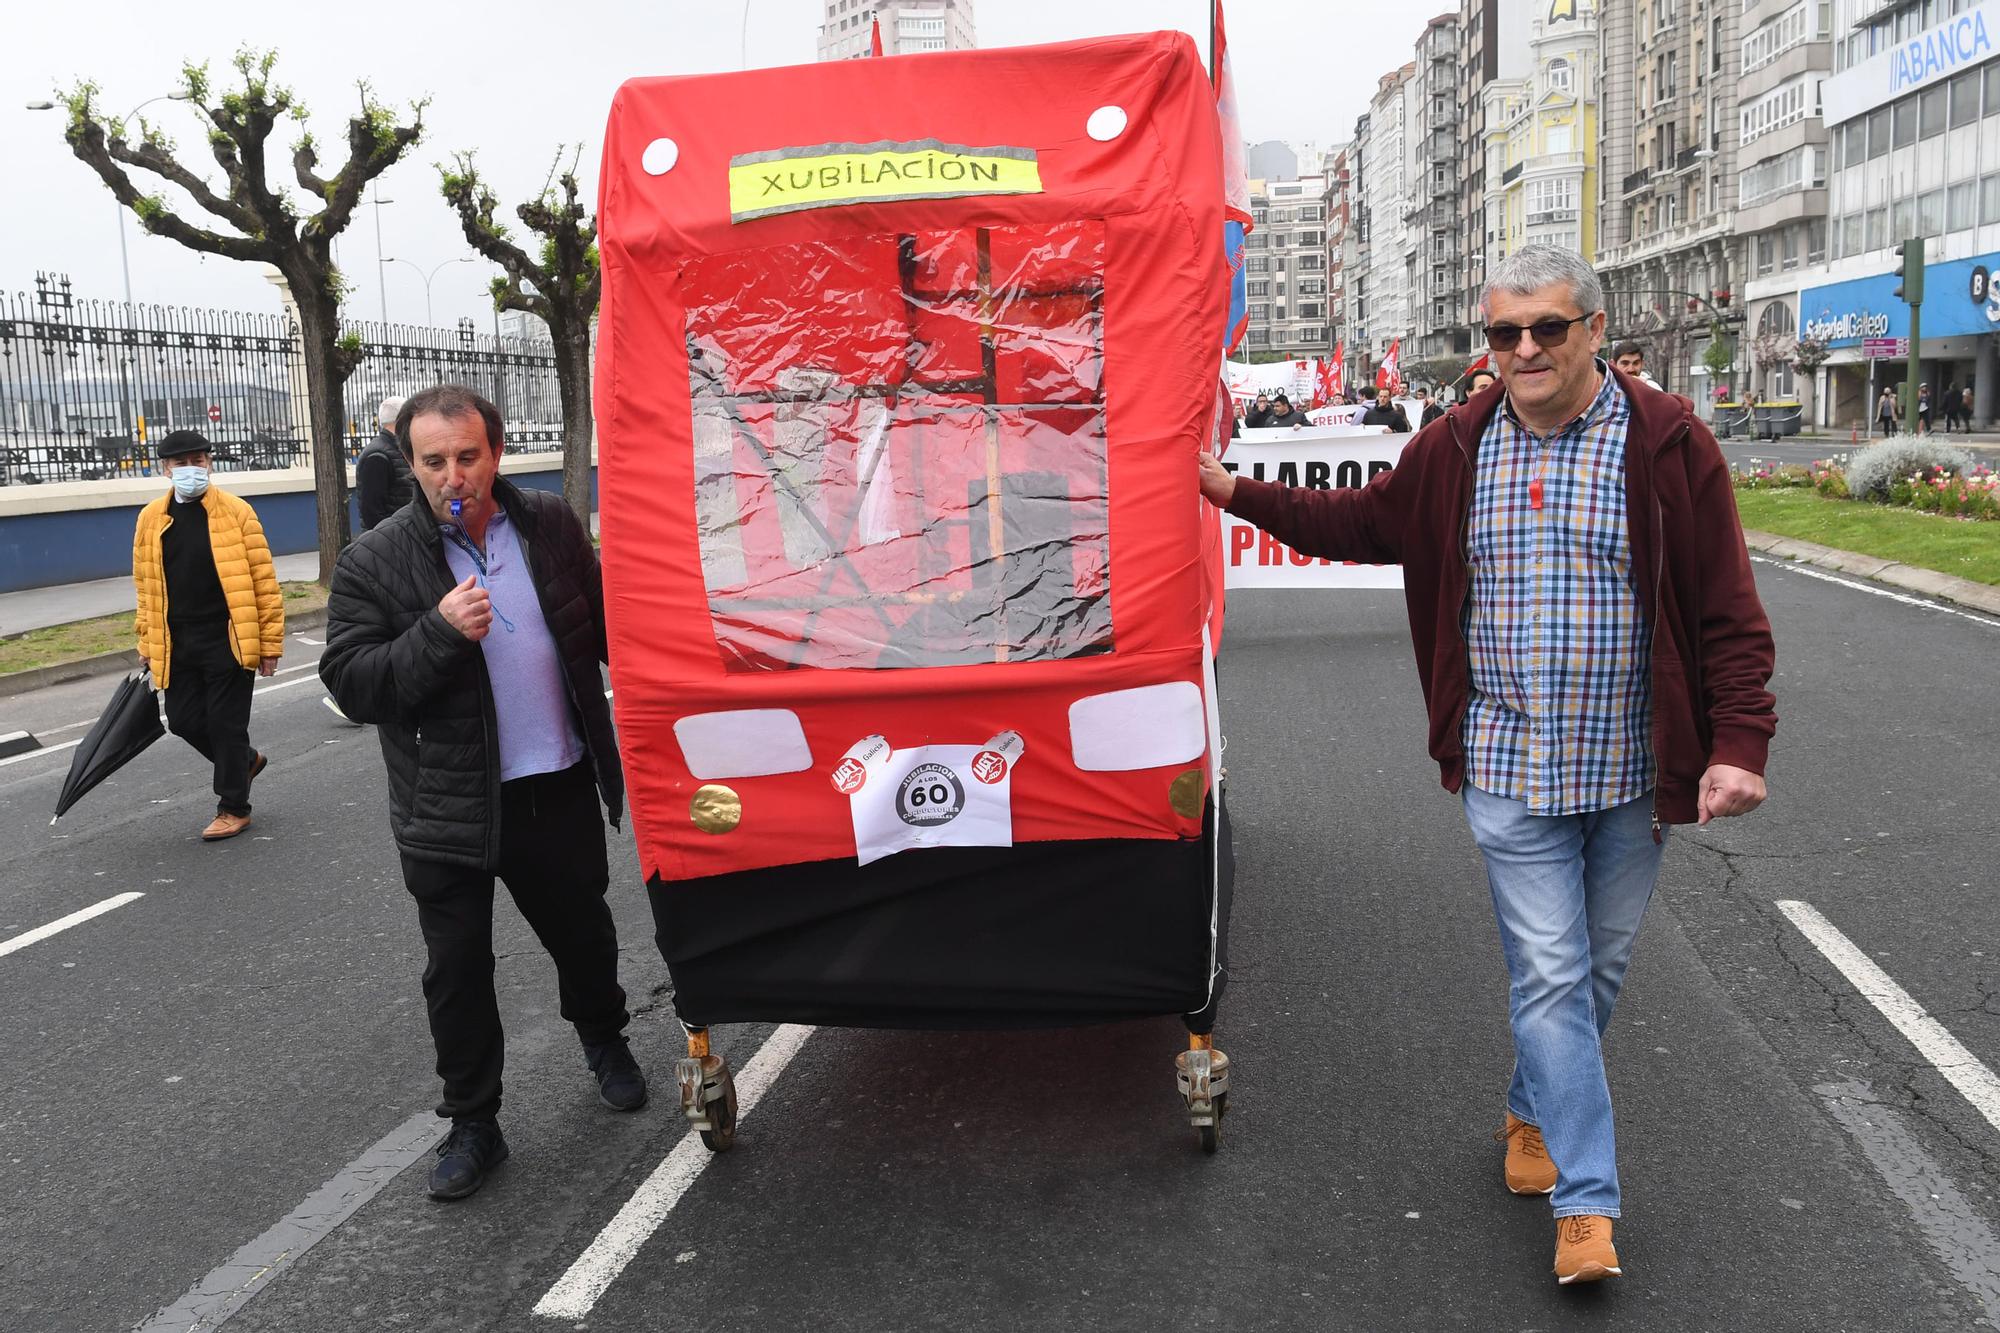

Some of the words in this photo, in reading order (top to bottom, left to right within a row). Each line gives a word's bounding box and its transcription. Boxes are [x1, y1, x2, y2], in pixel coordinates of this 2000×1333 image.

[862, 743, 883, 761] Galicia
[999, 736, 1017, 751] Galicia
[832, 759, 861, 787] UGT
[903, 764, 955, 788] JUBILACION
[973, 751, 1000, 780] UGT
[911, 784, 948, 807] 60
